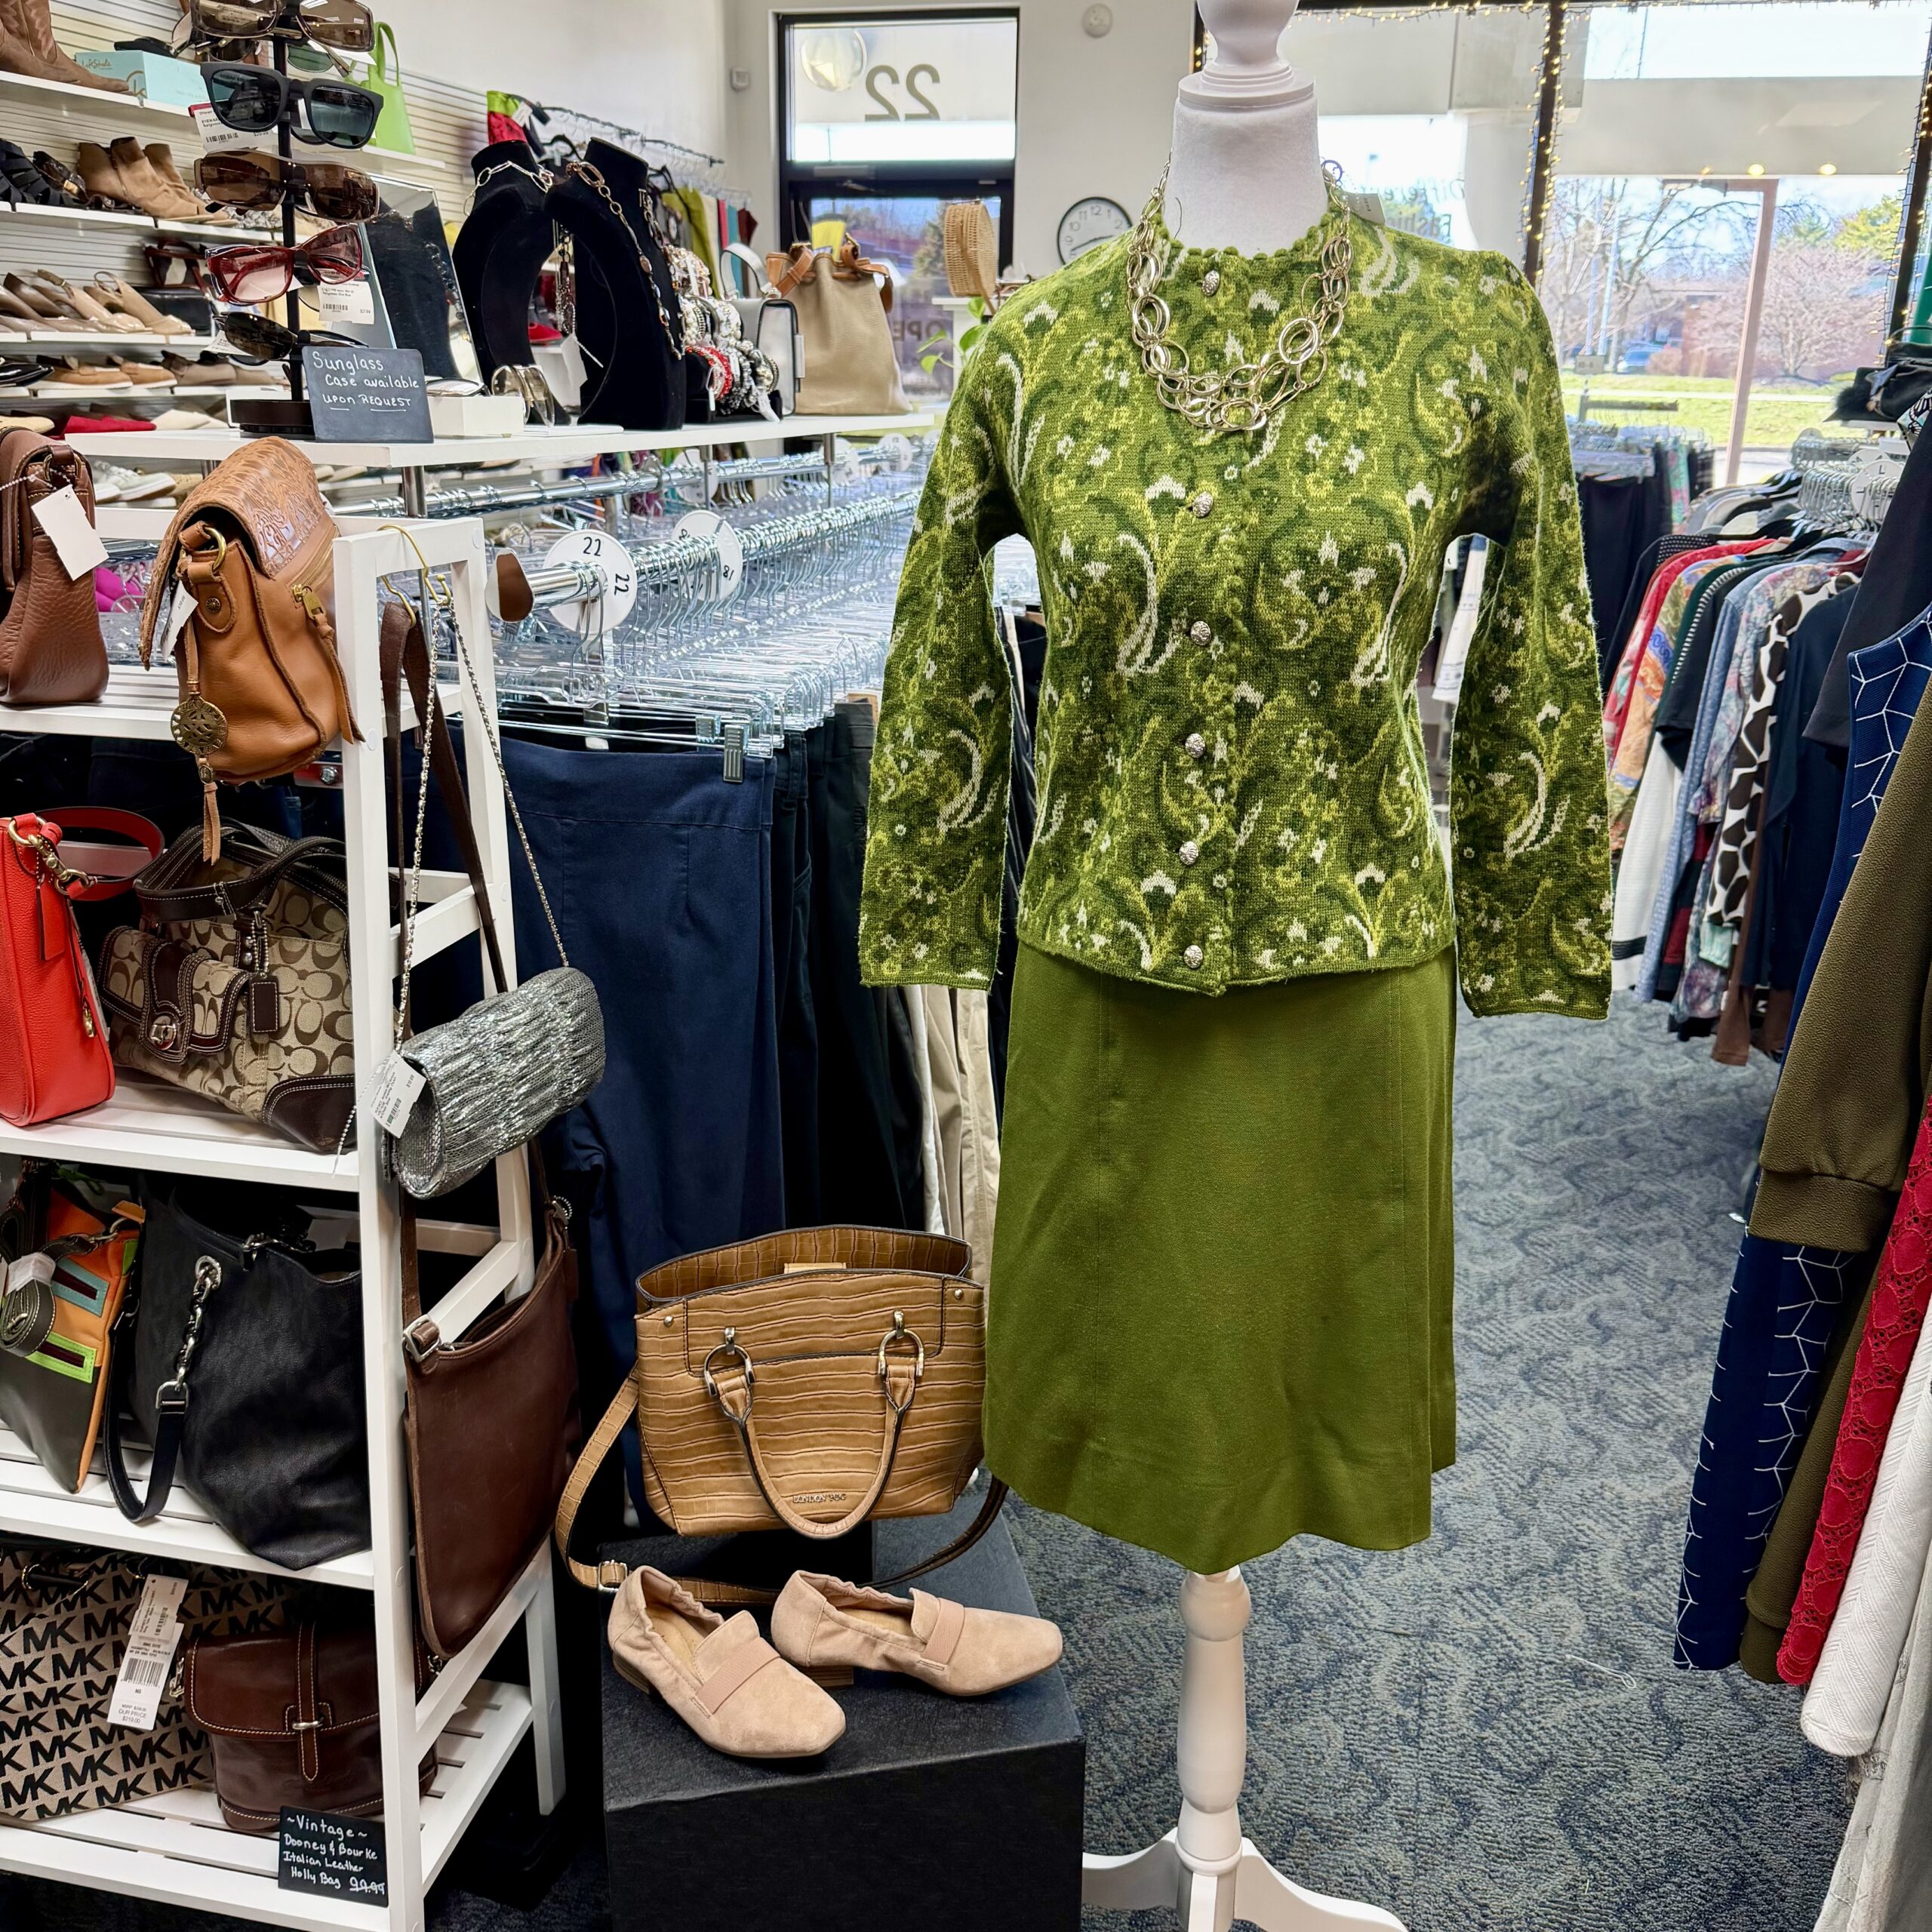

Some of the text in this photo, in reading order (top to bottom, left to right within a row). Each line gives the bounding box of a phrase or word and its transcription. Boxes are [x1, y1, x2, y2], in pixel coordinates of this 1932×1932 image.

[312, 351, 384, 375] Sunglass
[325, 374, 419, 389] Case available
[1878, 464, 1885, 475] L
[583, 537, 601, 557] 22
[614, 574, 629, 595] 22
[793, 1494, 826, 1503] LONDON
[23, 1616, 79, 1654] MK
[52, 1643, 107, 1681] MK
[23, 1683, 81, 1711] MK
[122, 1715, 140, 1724] $219.00
[131, 1710, 147, 1718] PRICE
[29, 1730, 87, 1767] MK
[120, 1730, 177, 1772] MK
[62, 1748, 118, 1790] MK
[153, 1754, 208, 1792] MK
[2, 1766, 60, 1809] MK
[95, 1771, 152, 1807] MK
[284, 1833, 326, 1854] Dooney
[283, 1851, 364, 1872] Italian Leather
[291, 1866, 316, 1884] Holly
[319, 1872, 341, 1889] Bag
